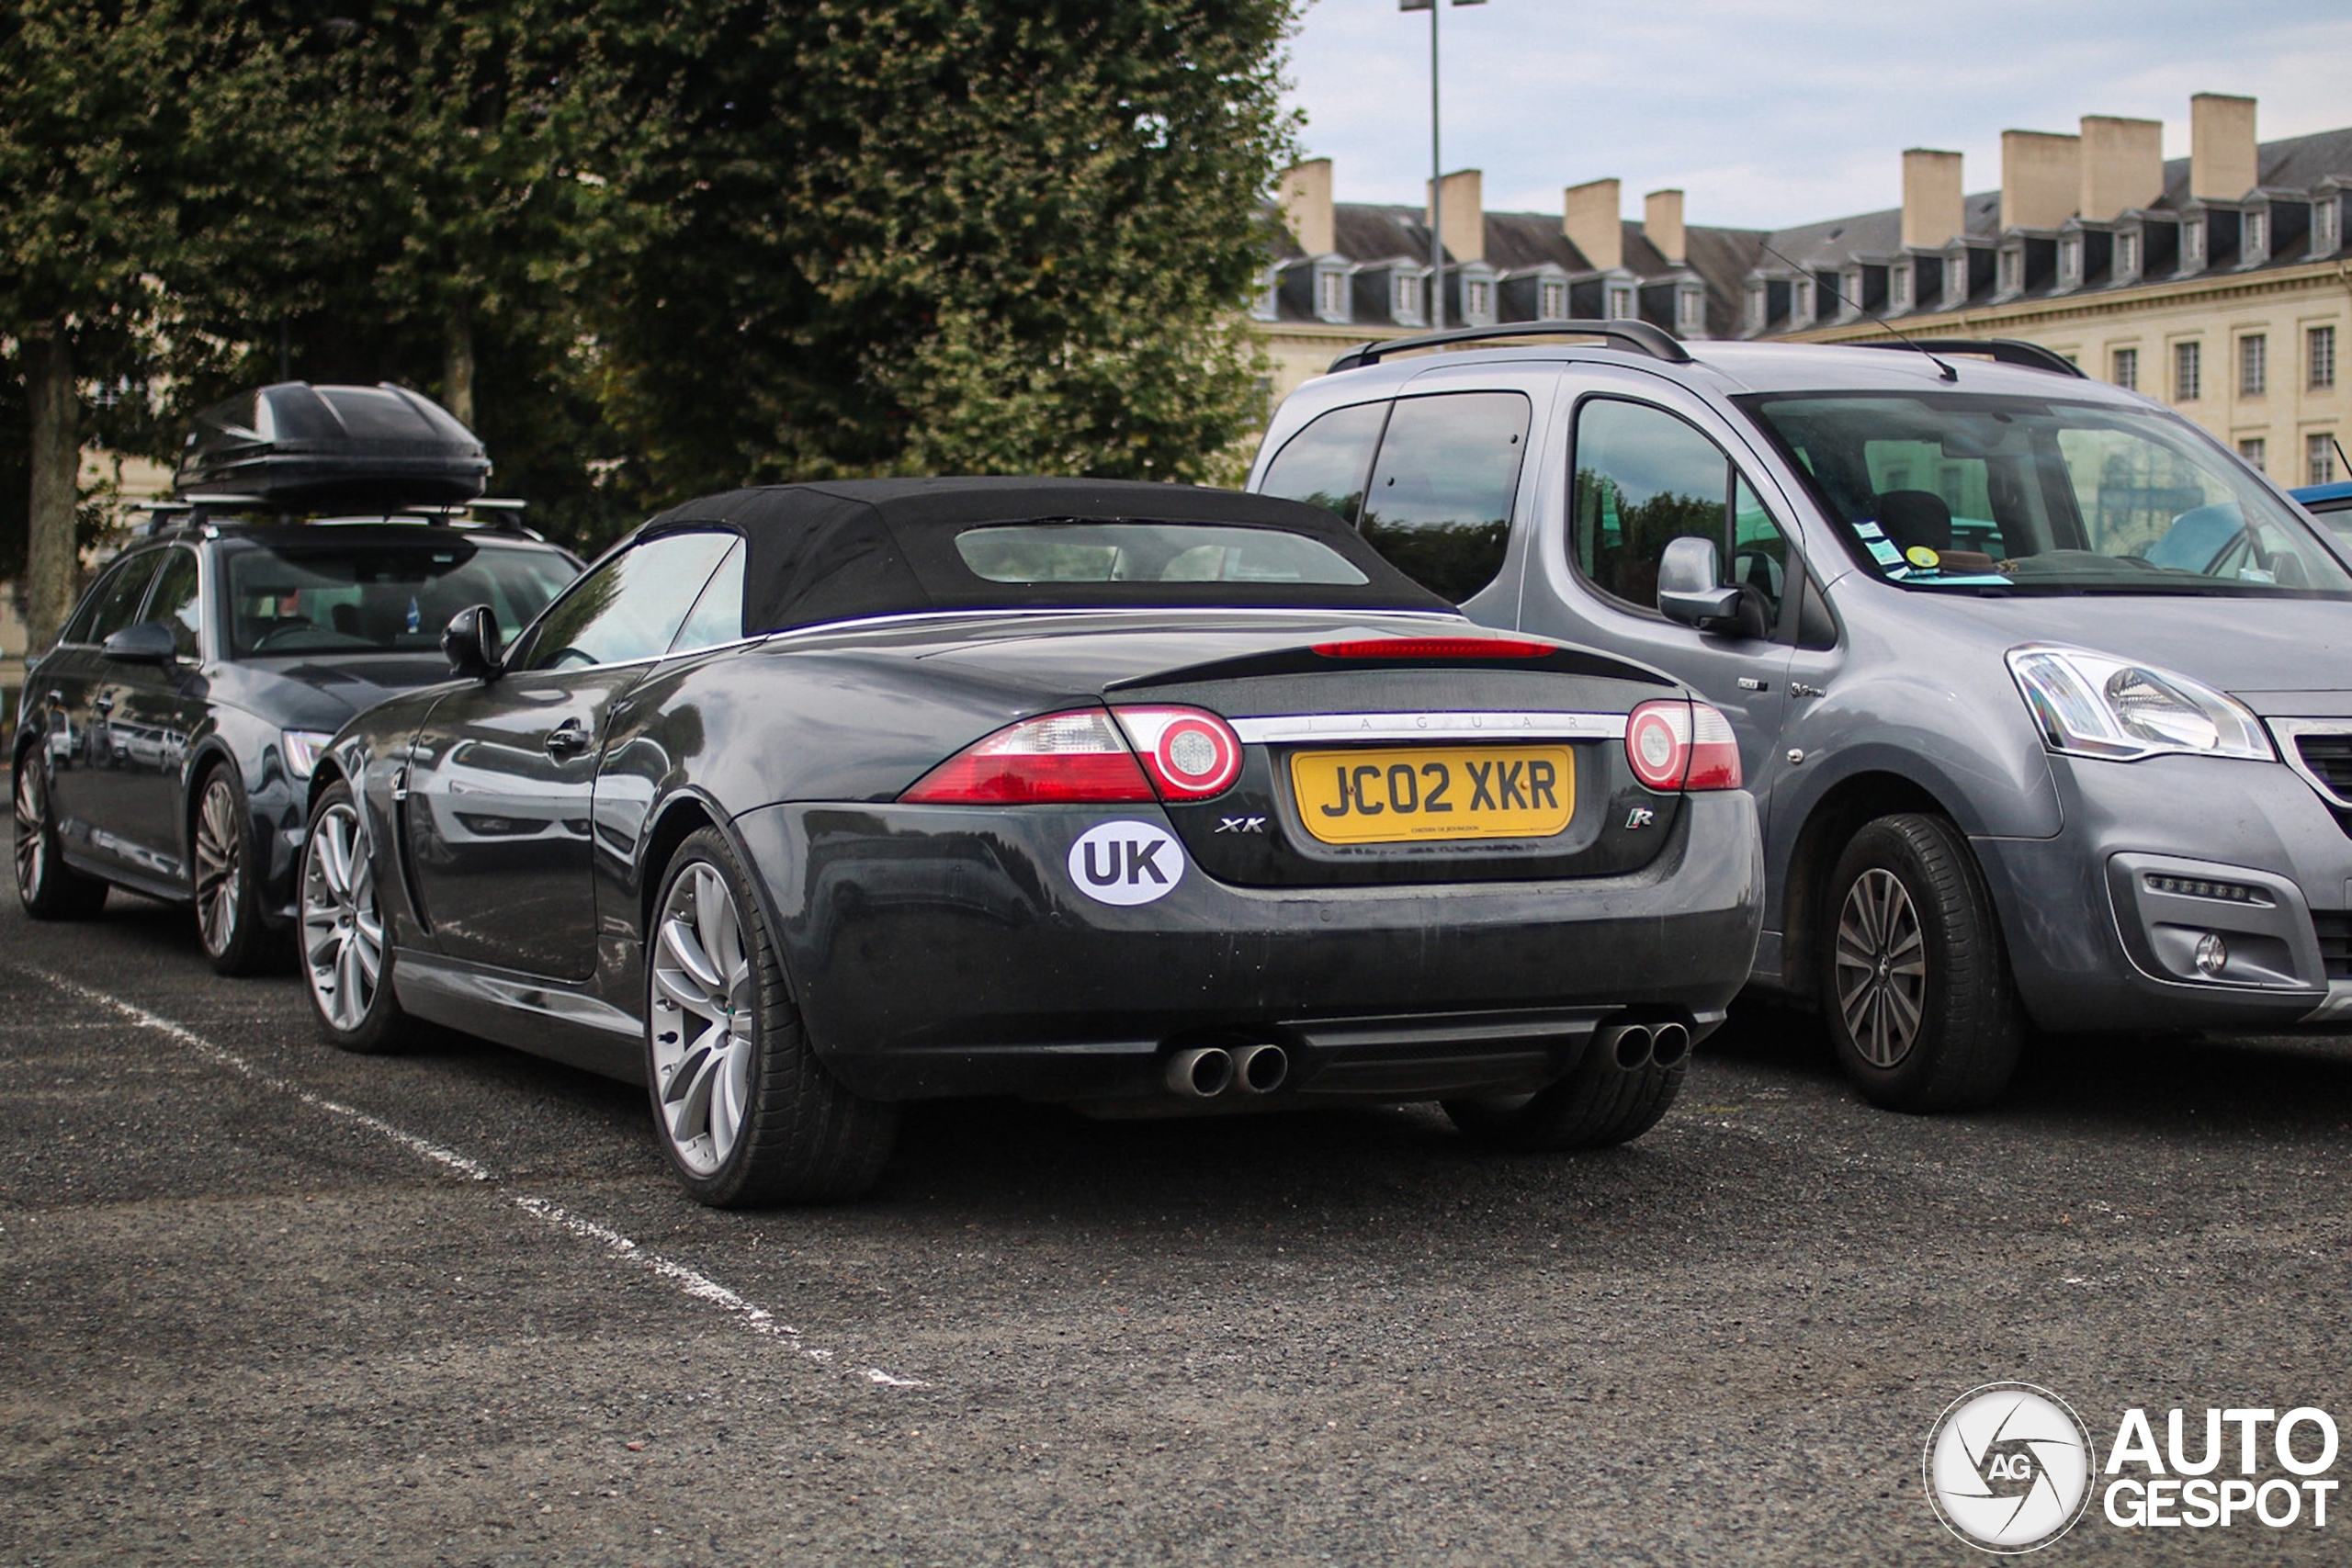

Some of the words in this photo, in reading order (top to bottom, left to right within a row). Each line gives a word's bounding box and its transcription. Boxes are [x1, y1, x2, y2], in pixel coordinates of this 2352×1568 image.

[1307, 716, 1578, 731] JAGUAR
[1320, 762, 1453, 818] JC02
[1464, 760, 1559, 812] XKR
[1214, 817, 1266, 834] XK
[1083, 840, 1170, 887] UK
